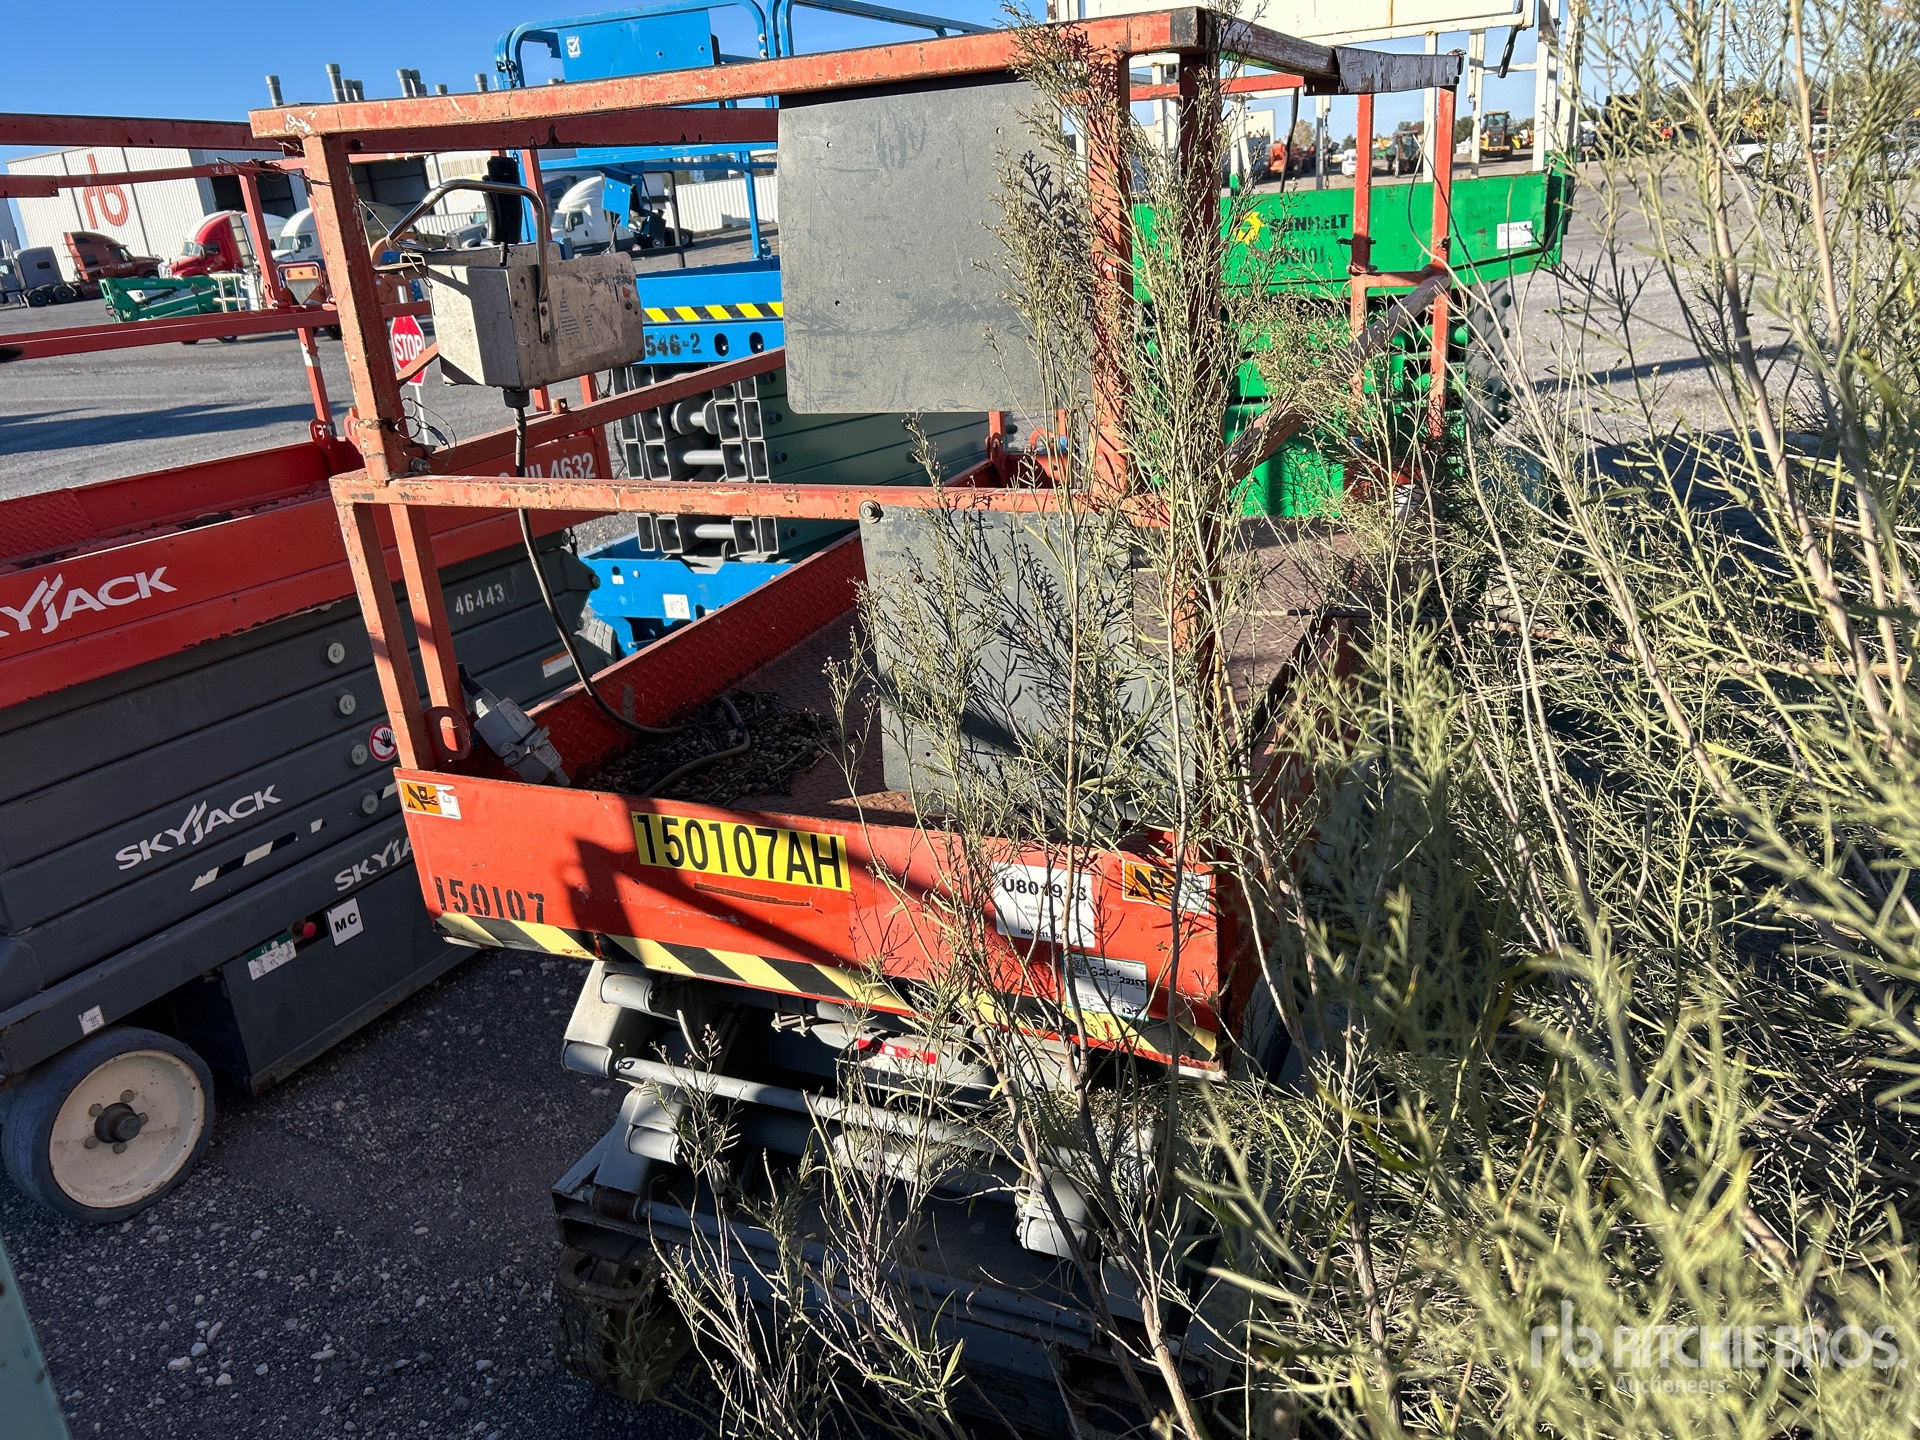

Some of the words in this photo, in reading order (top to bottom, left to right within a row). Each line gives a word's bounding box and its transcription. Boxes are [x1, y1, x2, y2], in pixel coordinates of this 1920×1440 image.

[394, 333, 423, 361] STOP
[551, 452, 596, 479] 4632
[456, 583, 505, 615] 46443
[115, 784, 282, 870] SKYJACK
[637, 815, 843, 889] 150107AH
[434, 876, 545, 924] 150107
